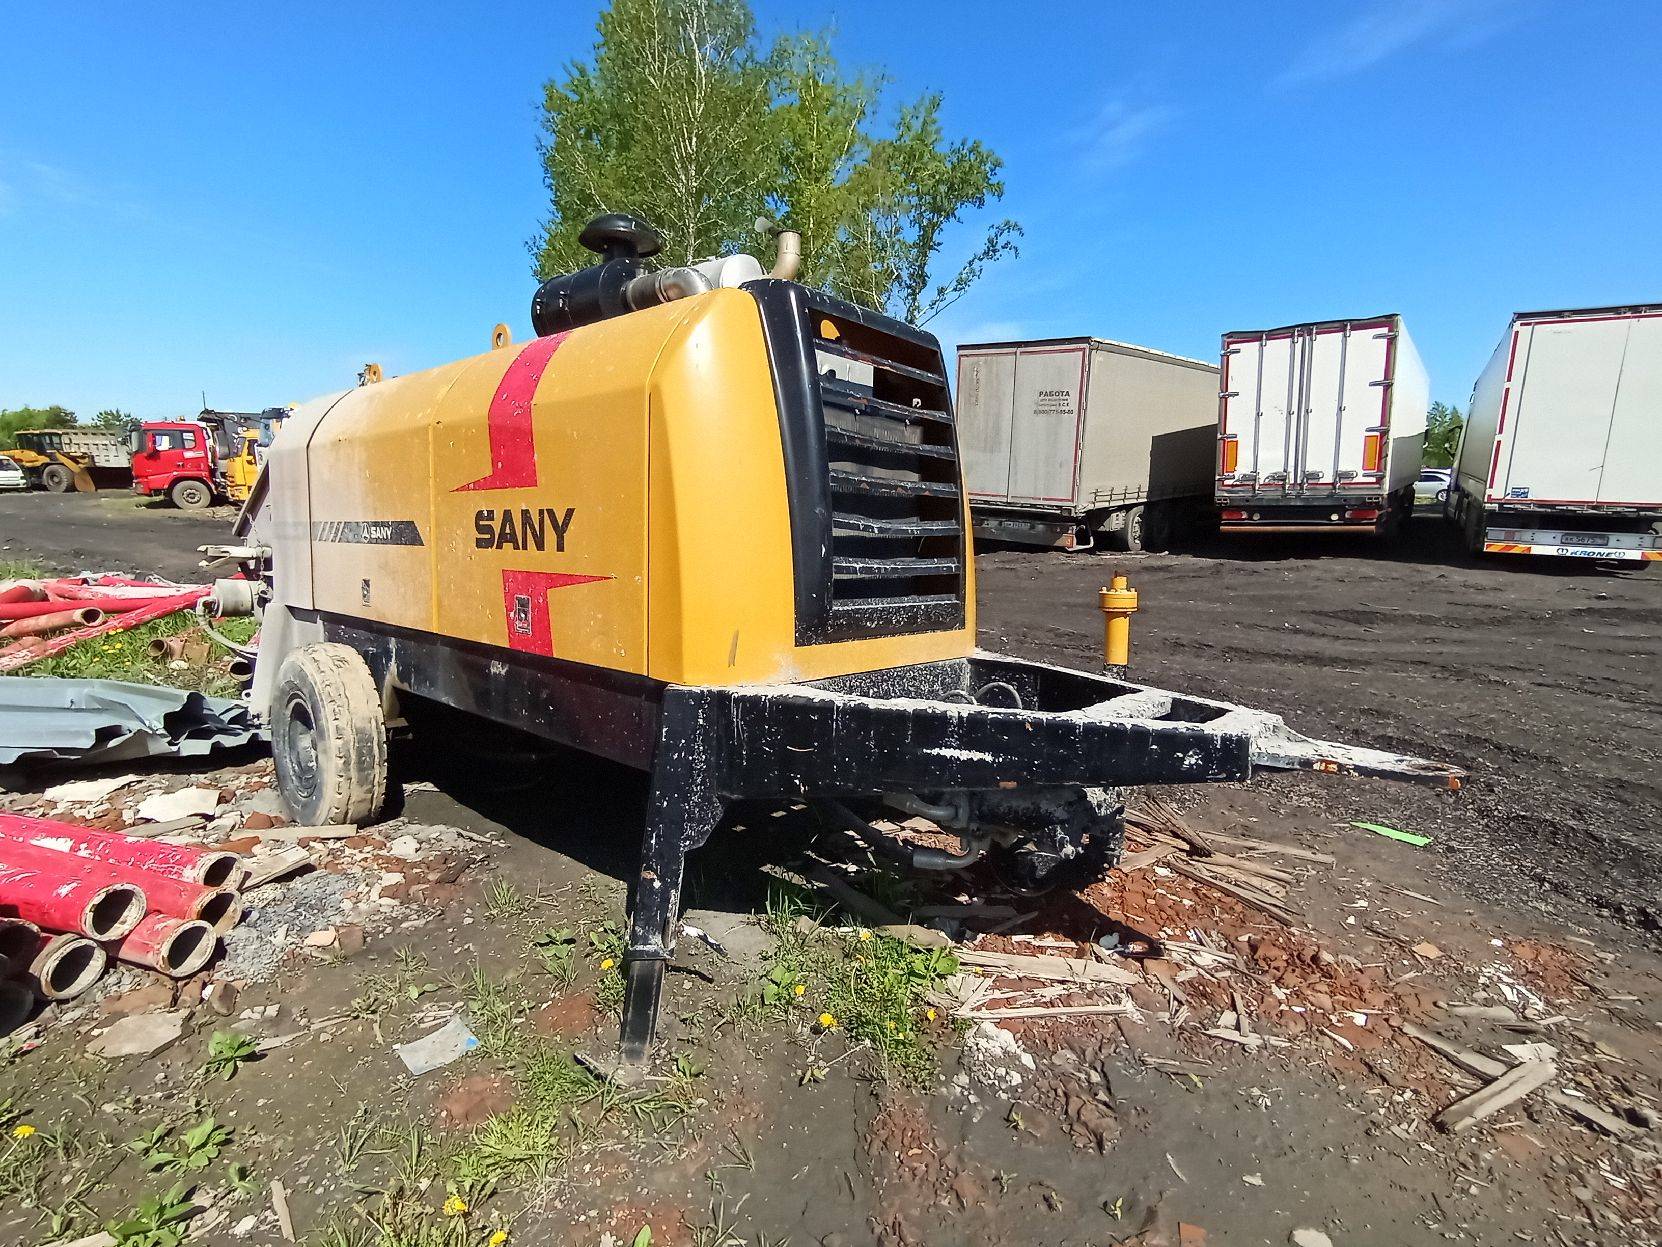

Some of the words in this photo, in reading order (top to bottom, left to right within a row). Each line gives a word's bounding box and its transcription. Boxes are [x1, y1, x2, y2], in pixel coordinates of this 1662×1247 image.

[370, 525, 392, 540] SANY
[475, 507, 576, 552] SANY
[1570, 550, 1614, 558] KRONE
